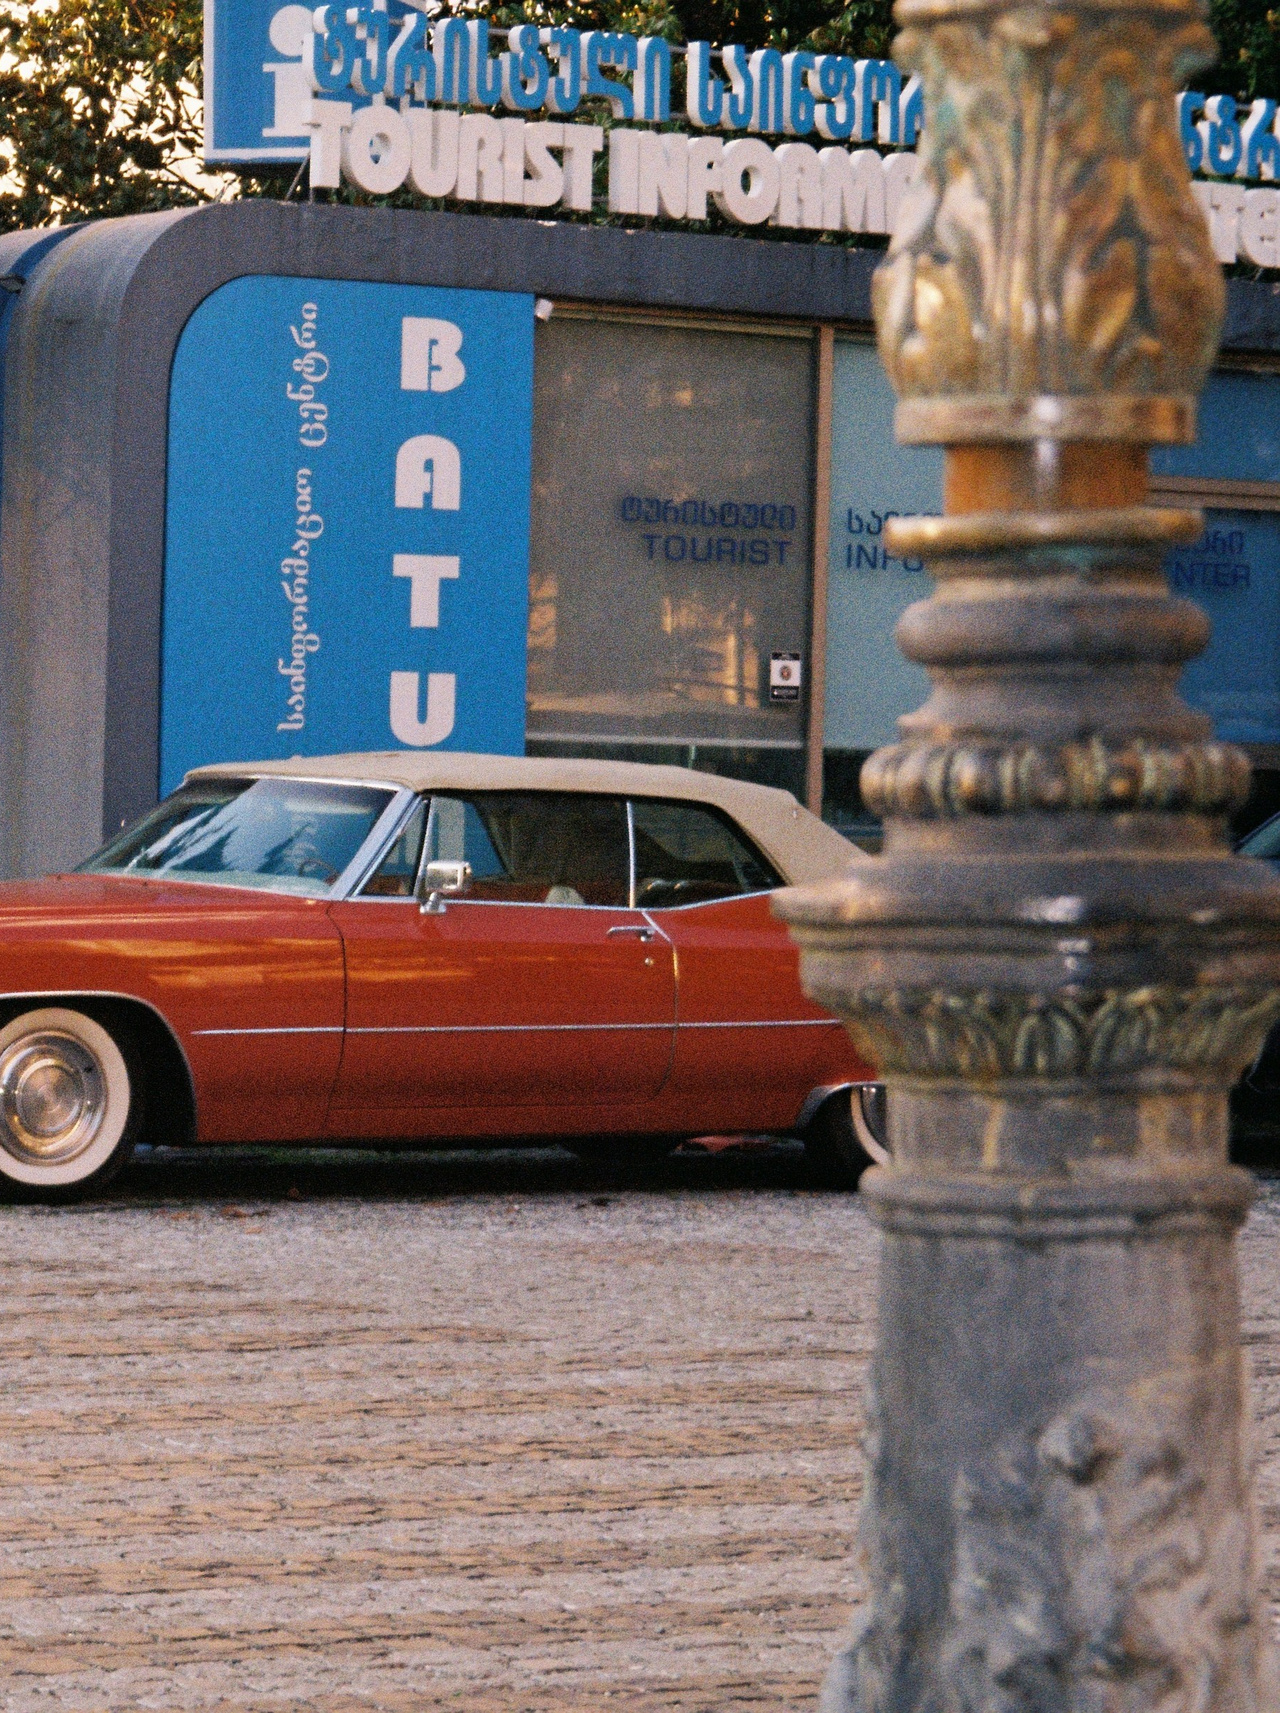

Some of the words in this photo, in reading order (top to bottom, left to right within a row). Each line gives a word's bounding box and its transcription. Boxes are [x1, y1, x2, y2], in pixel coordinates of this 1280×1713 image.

[313, 4, 671, 122] ტურისტული
[306, 98, 604, 212] TOURIST
[287, 301, 331, 448] ცენტრი
[277, 467, 325, 733] საინფორმაციო
[642, 533, 792, 566] TOURIST
